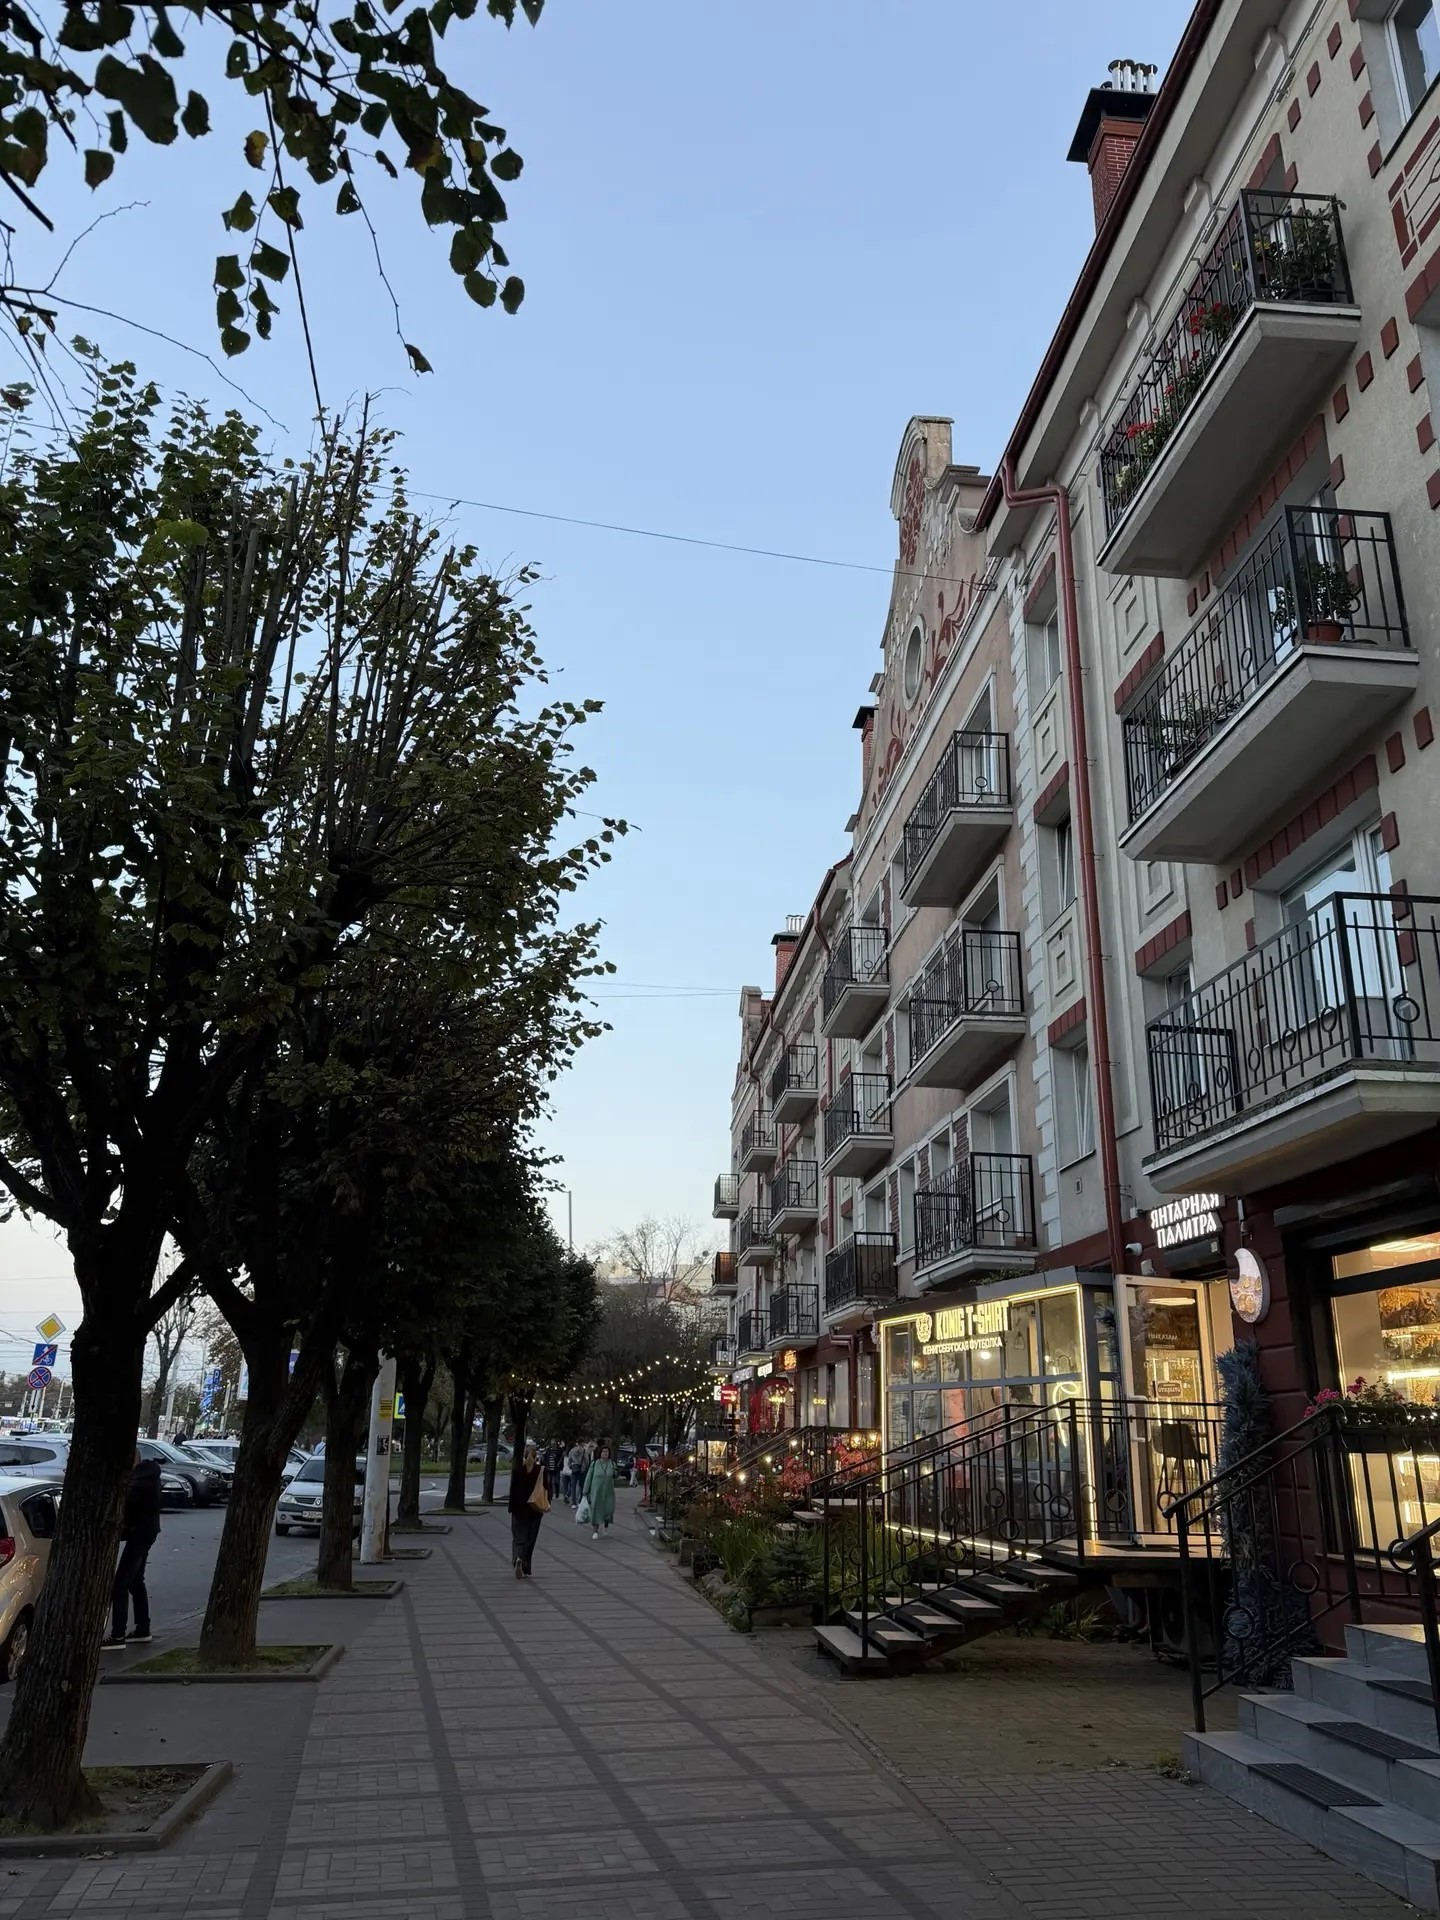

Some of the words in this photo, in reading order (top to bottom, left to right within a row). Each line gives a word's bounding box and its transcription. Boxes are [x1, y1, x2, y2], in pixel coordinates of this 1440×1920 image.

[1151, 1194, 1219, 1229] ЯНТАРНАЯ
[1157, 1212, 1217, 1248] ПАЛИТРА
[966, 1300, 1009, 1335] T-SHIRT
[969, 1336, 1003, 1351] ФУТБОЛКА
